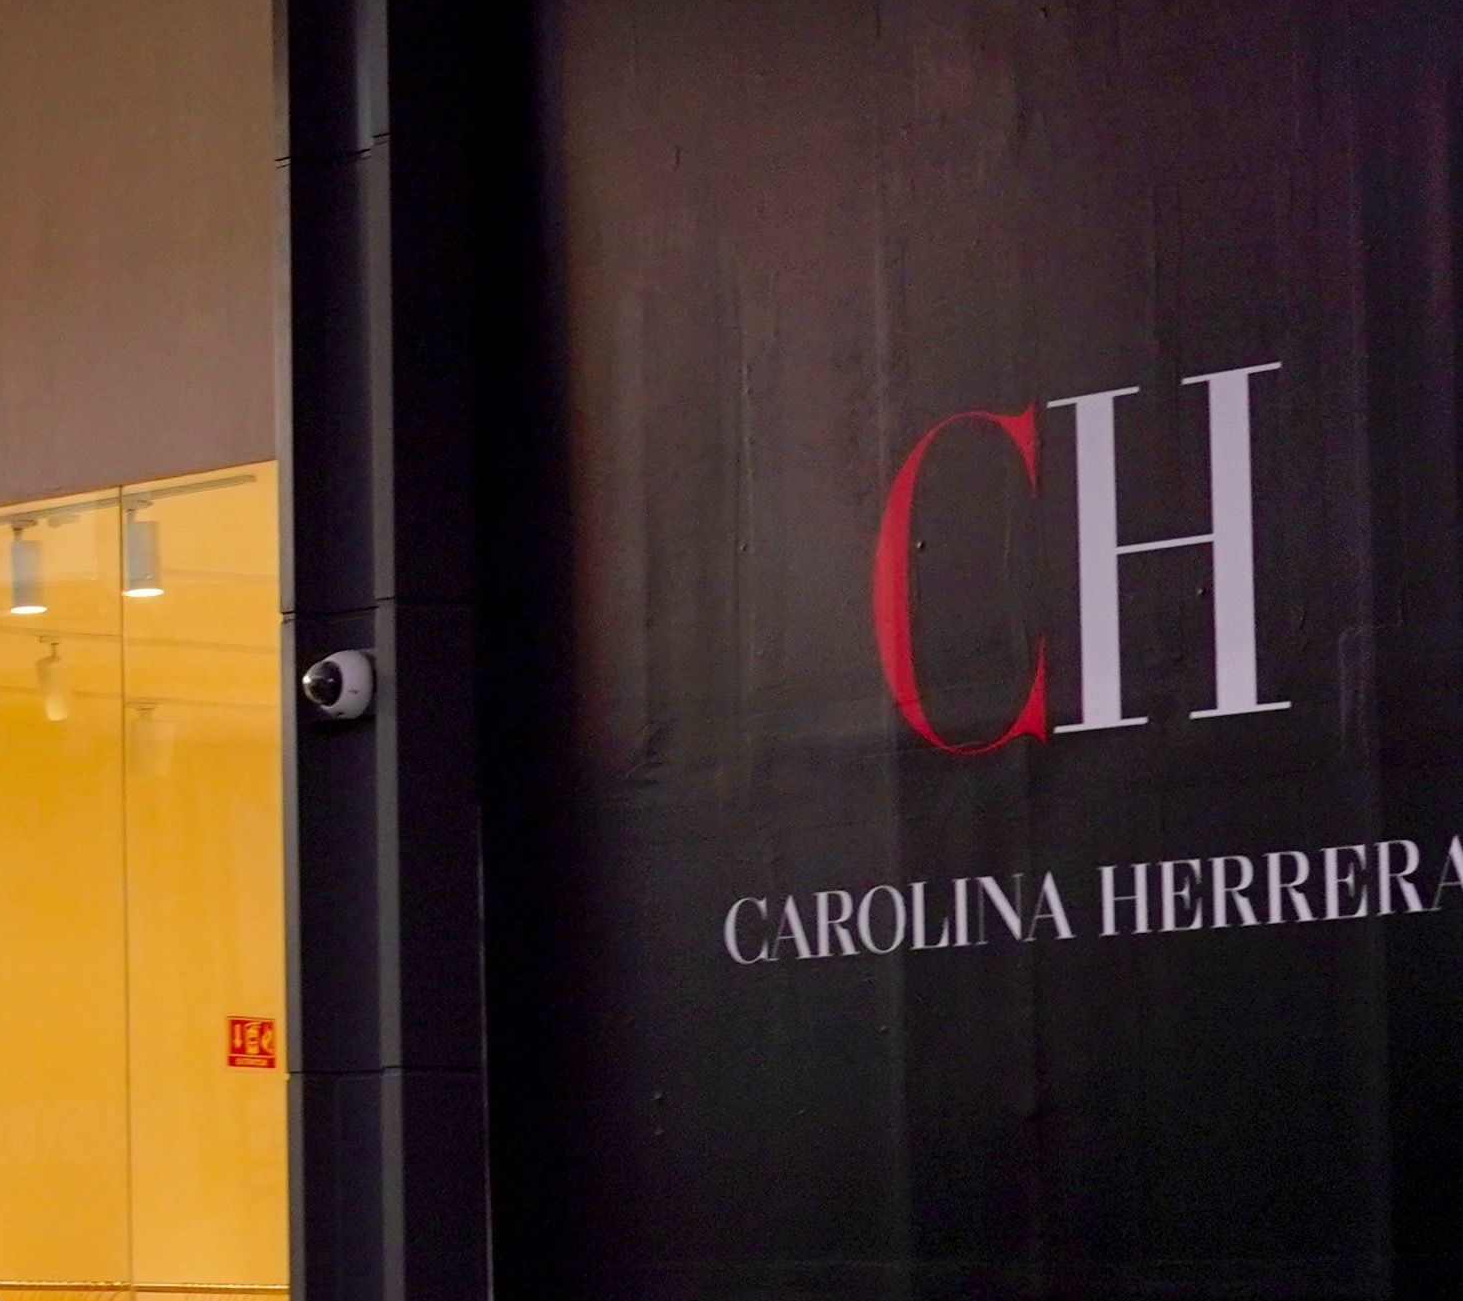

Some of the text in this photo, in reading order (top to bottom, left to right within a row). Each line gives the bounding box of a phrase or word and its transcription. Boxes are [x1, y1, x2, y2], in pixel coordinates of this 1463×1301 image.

[873, 361, 1292, 756] CH
[723, 833, 1463, 966] CAROLINA HERRERA
